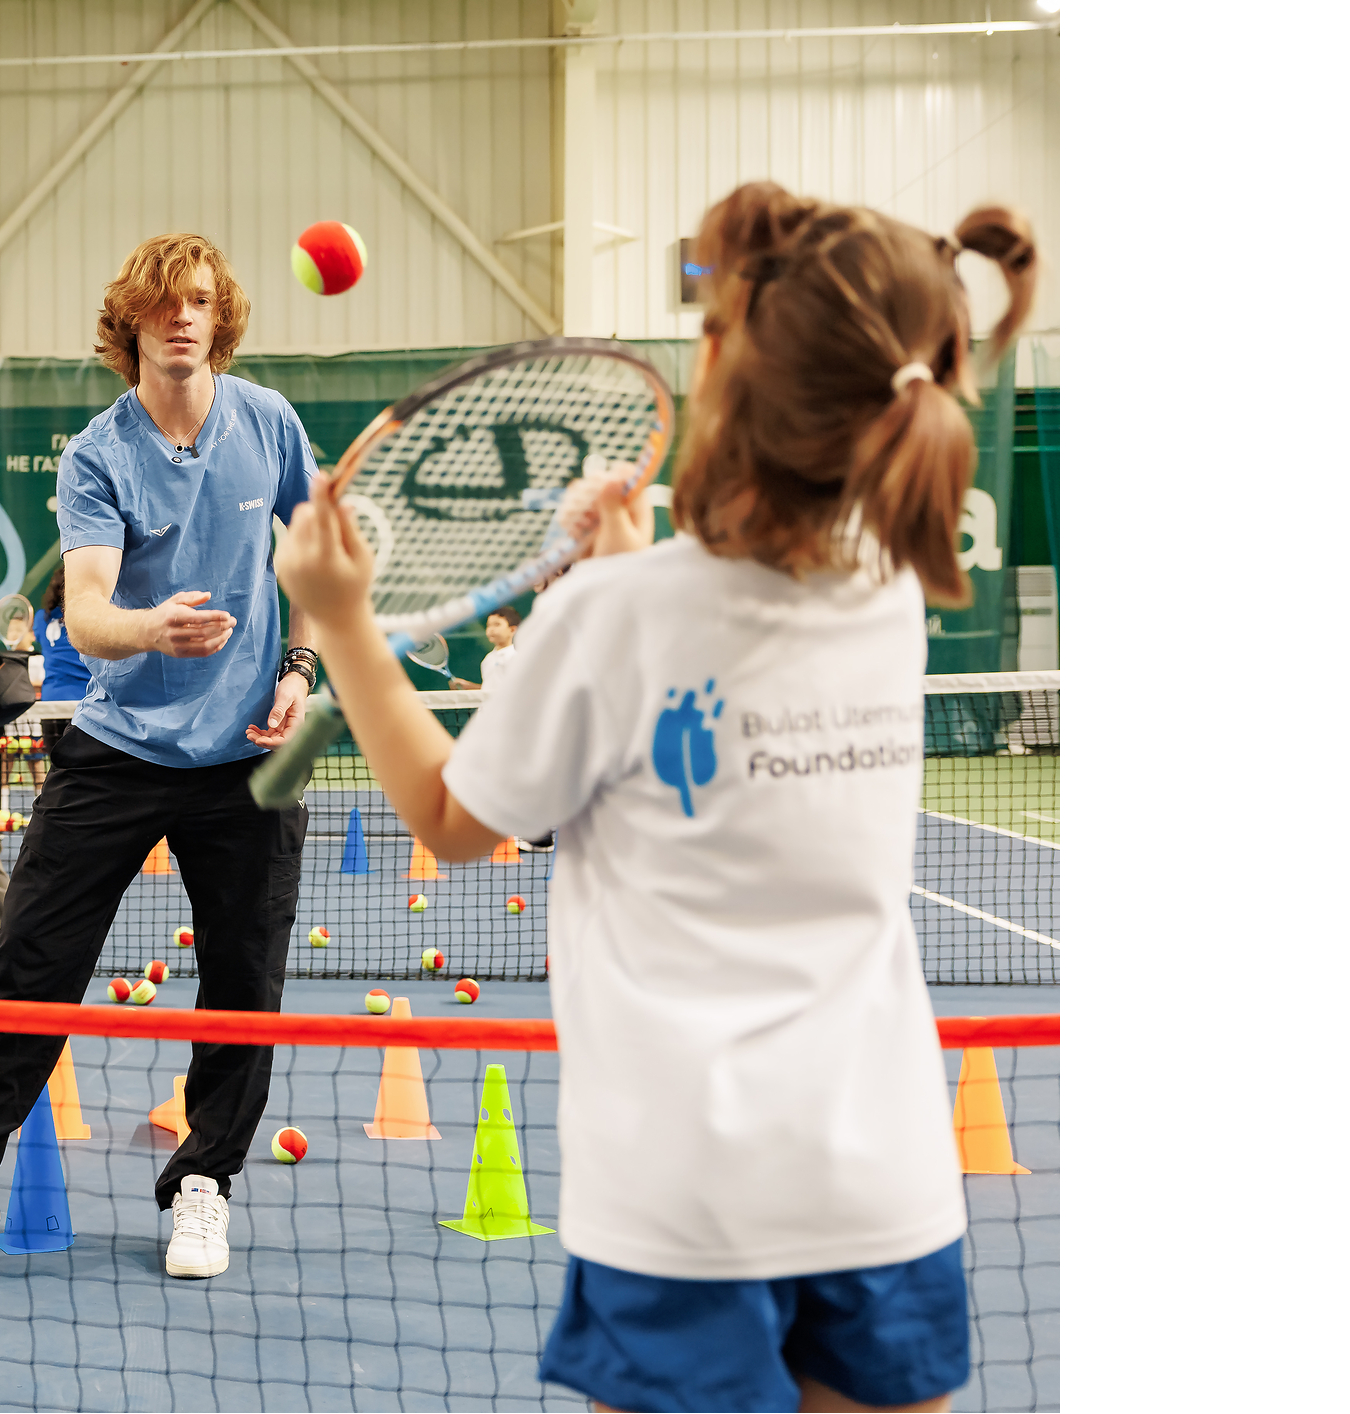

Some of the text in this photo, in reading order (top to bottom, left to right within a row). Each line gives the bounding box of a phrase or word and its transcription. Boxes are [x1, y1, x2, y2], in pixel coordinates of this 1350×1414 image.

[218, 430, 230, 443] FOR
[226, 420, 236, 432] THE
[6, 455, 30, 473] НЕ
[238, 498, 264, 512] K-SWISS
[741, 707, 821, 738] Bulat
